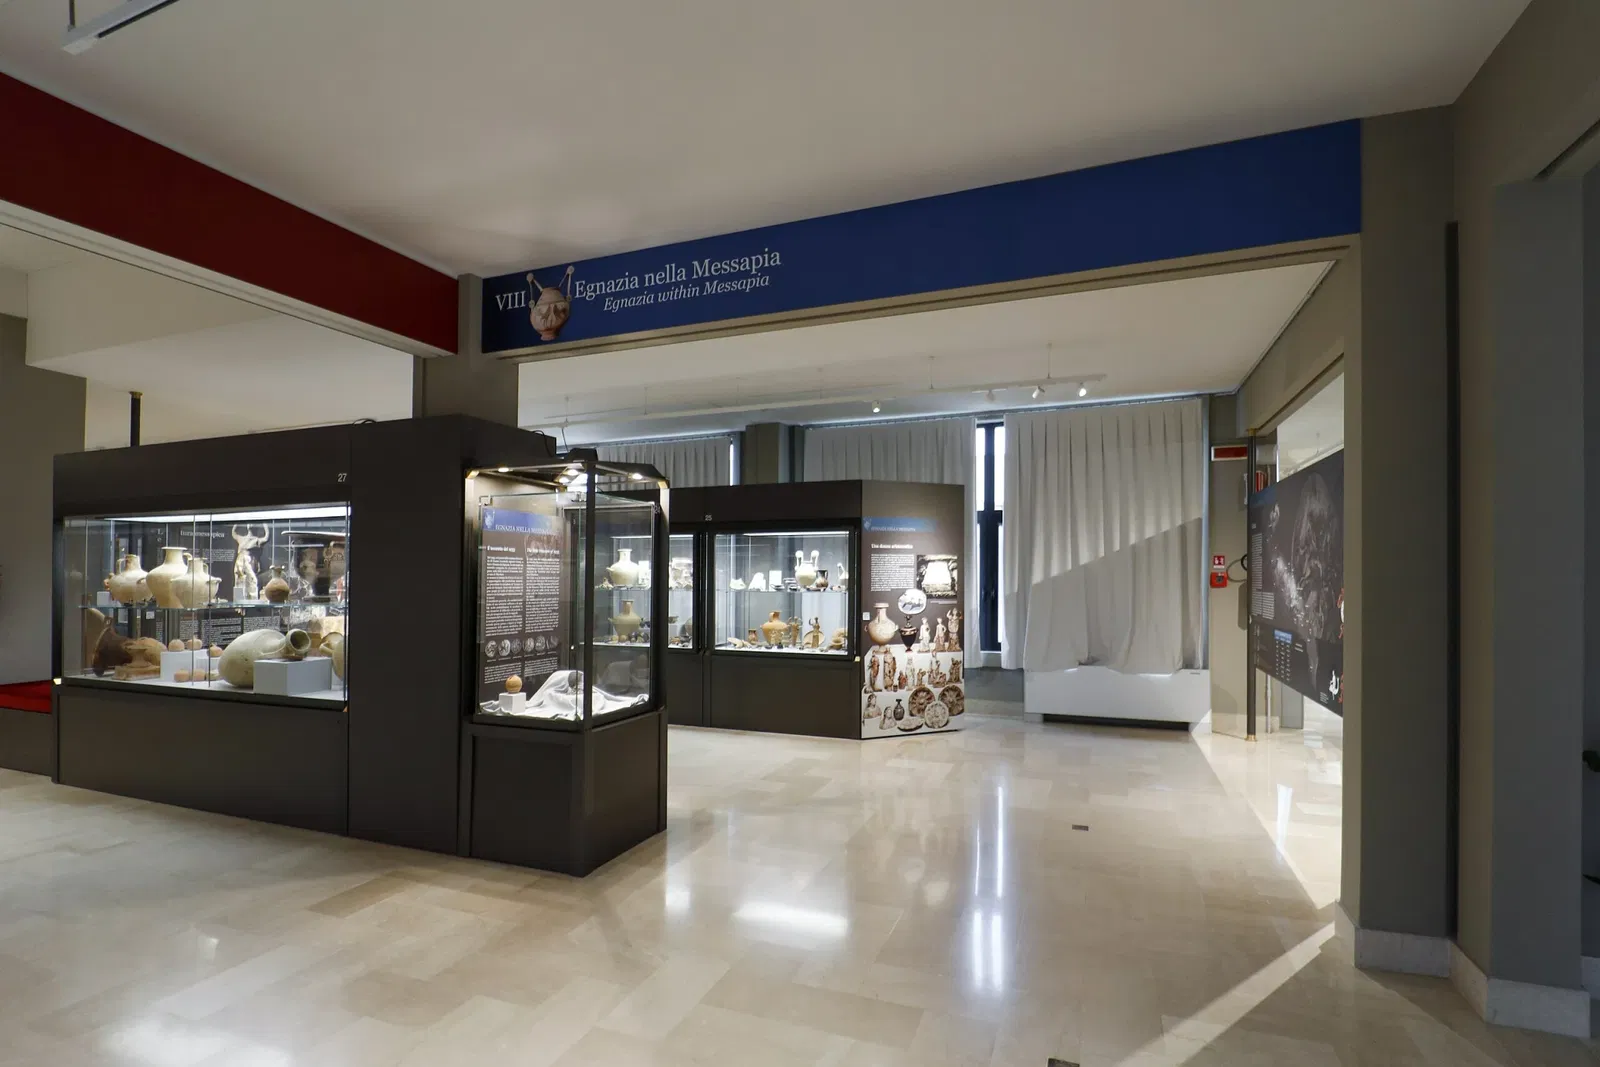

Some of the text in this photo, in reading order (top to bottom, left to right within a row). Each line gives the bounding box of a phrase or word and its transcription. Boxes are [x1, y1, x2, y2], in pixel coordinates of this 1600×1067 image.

[574, 247, 781, 300] Egnazia nella Messapia
[495, 291, 526, 311] VIII
[603, 275, 770, 312] Egnazia within Messapia
[338, 473, 347, 482] 27
